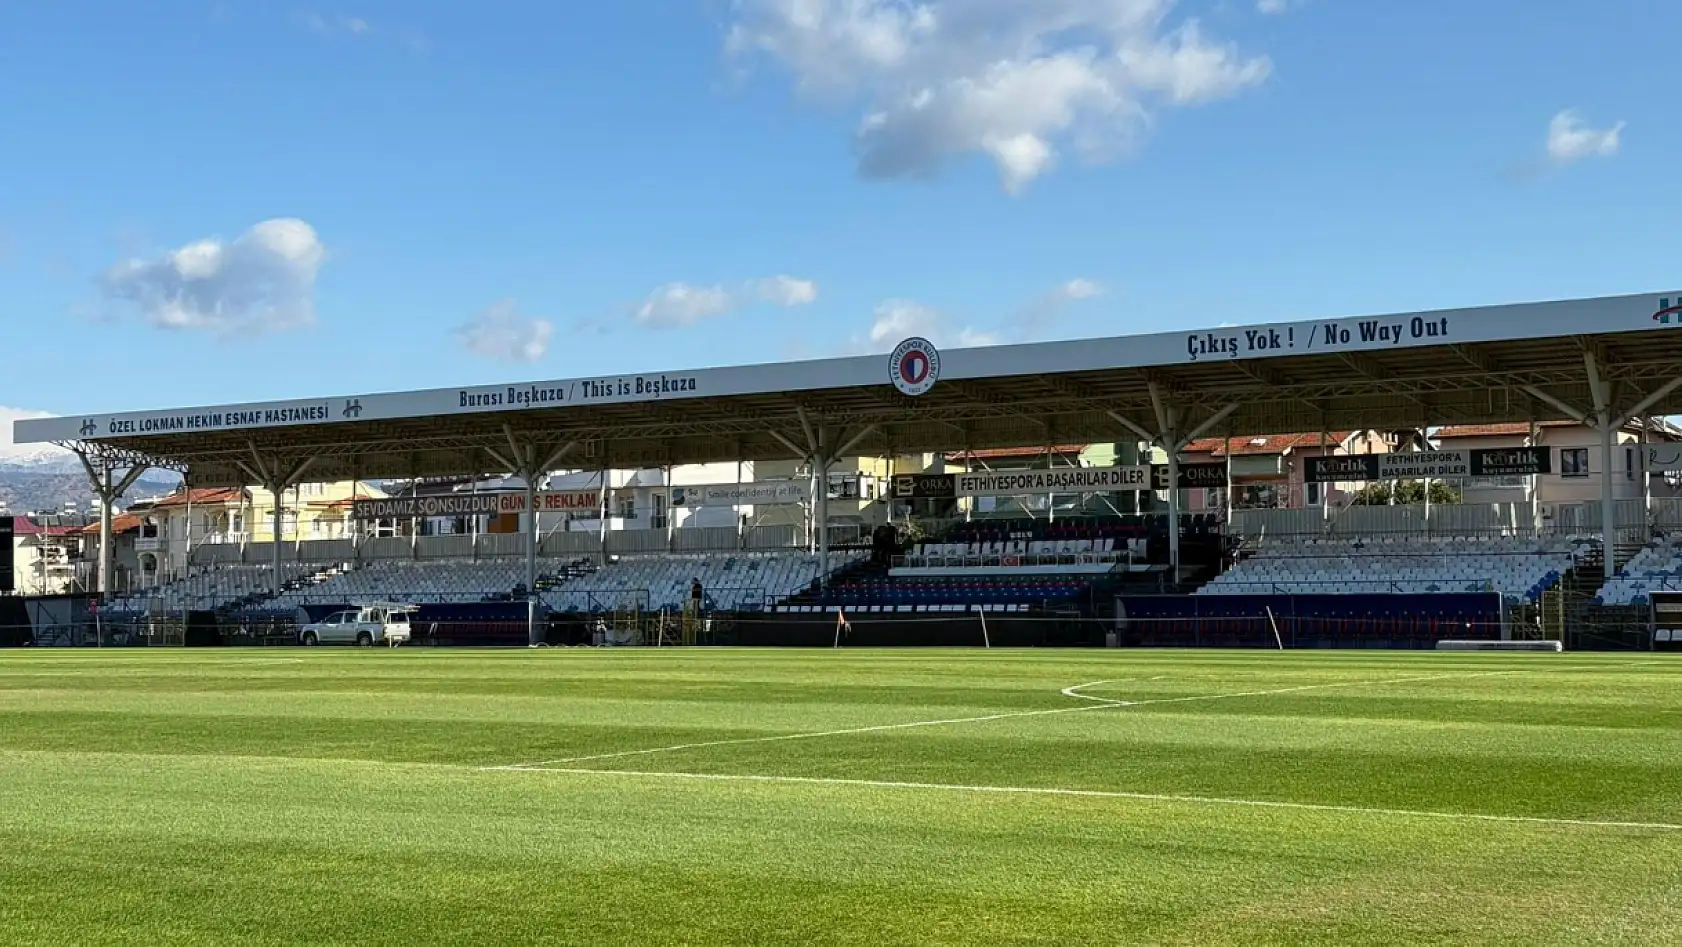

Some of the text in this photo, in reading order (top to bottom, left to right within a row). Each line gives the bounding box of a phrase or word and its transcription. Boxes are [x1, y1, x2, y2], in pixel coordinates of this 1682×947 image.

[1187, 333, 1238, 360] Çıkış
[1246, 329, 1281, 350] Yok
[1324, 324, 1350, 345] No
[1359, 321, 1402, 344] Way
[1411, 316, 1448, 338] Out
[459, 391, 503, 407] Burası
[507, 386, 563, 408] Beşkaza
[582, 380, 613, 398] This
[618, 378, 631, 395] is
[636, 375, 697, 398] Beşkaza
[109, 401, 329, 433] ÖZEL LOKMAN HEKİM ESNAF HASTANESİ
[1046, 471, 1108, 490] BAŞARILAR
[1111, 468, 1144, 484] DİLER
[1186, 467, 1225, 480] ORKA
[357, 497, 497, 517] SEVDAMIZ SONSUZDUR
[545, 493, 596, 509] REKLAM
